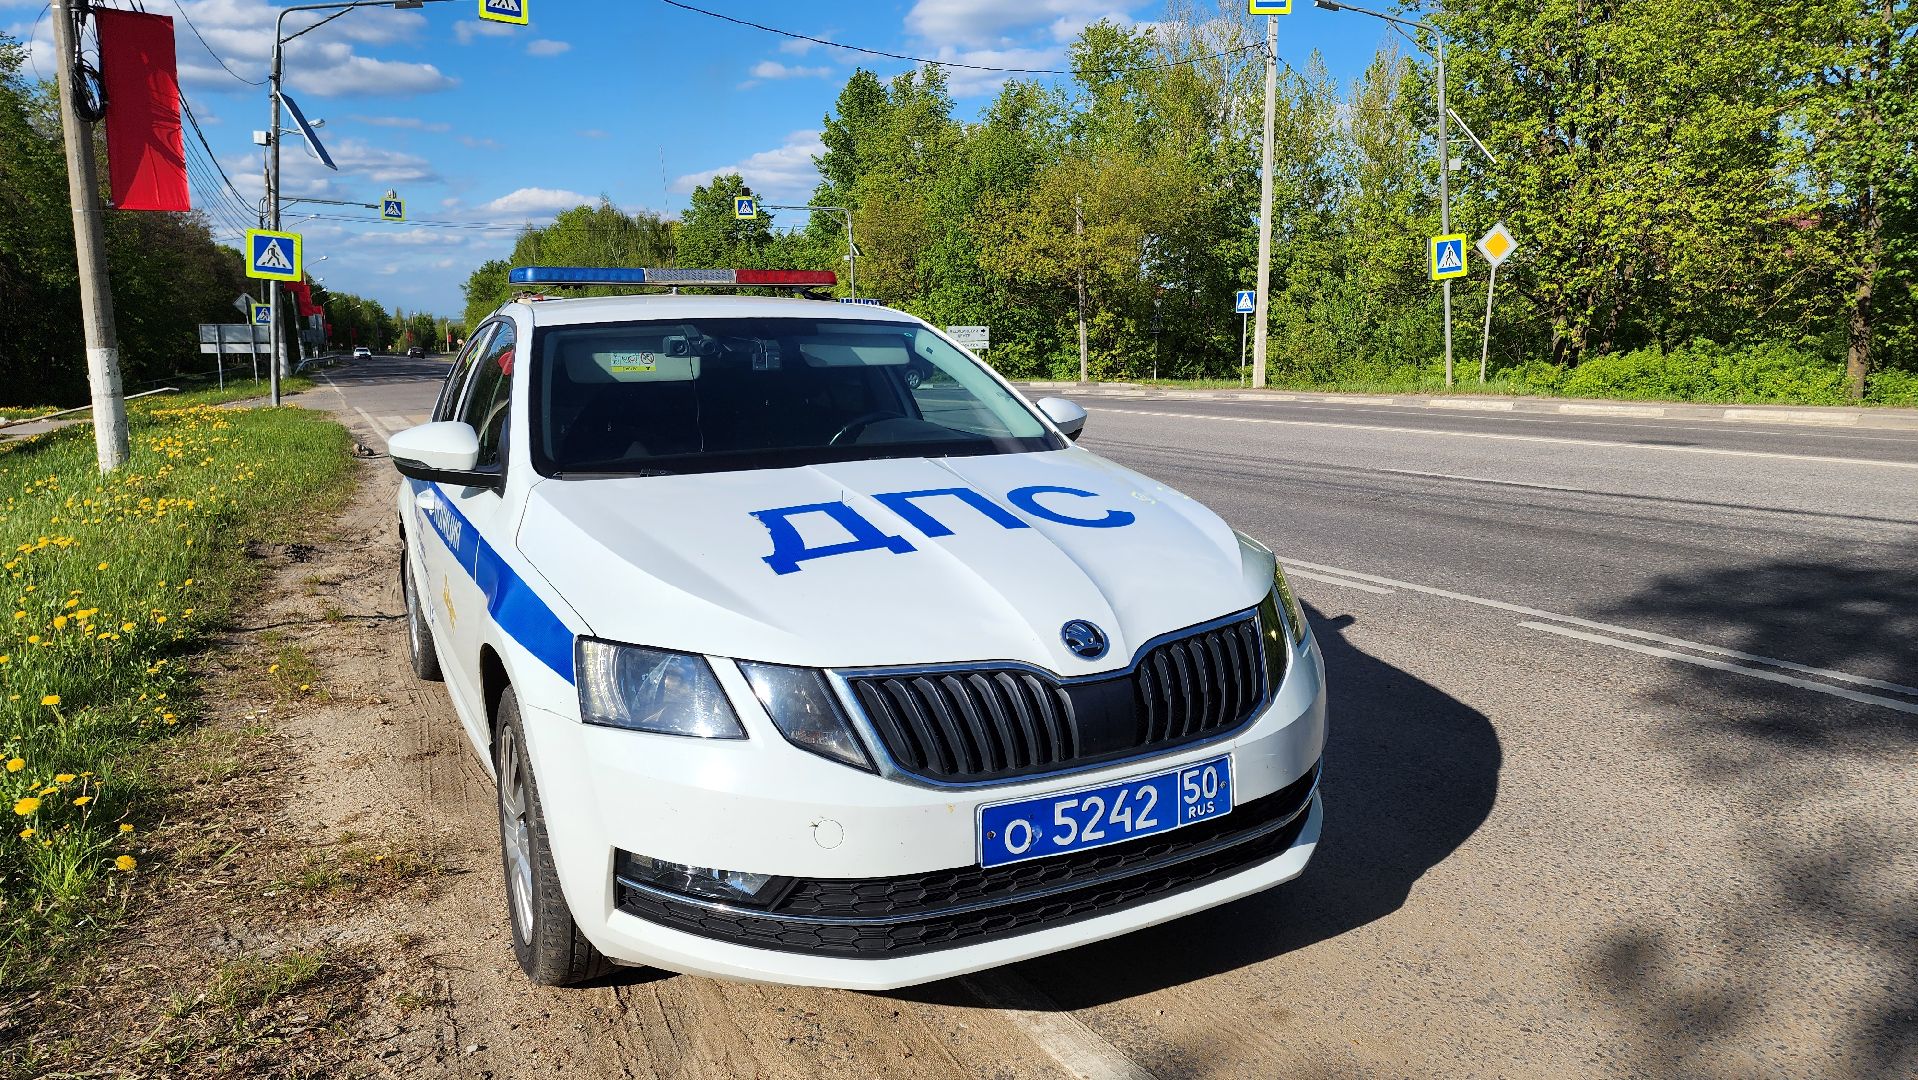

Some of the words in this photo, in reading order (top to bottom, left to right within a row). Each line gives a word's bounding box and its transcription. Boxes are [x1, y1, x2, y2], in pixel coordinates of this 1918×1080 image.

[748, 485, 1135, 575] ДПС
[1052, 784, 1158, 846] 5242
[1183, 766, 1218, 804] 50
[1188, 802, 1215, 819] RUS
